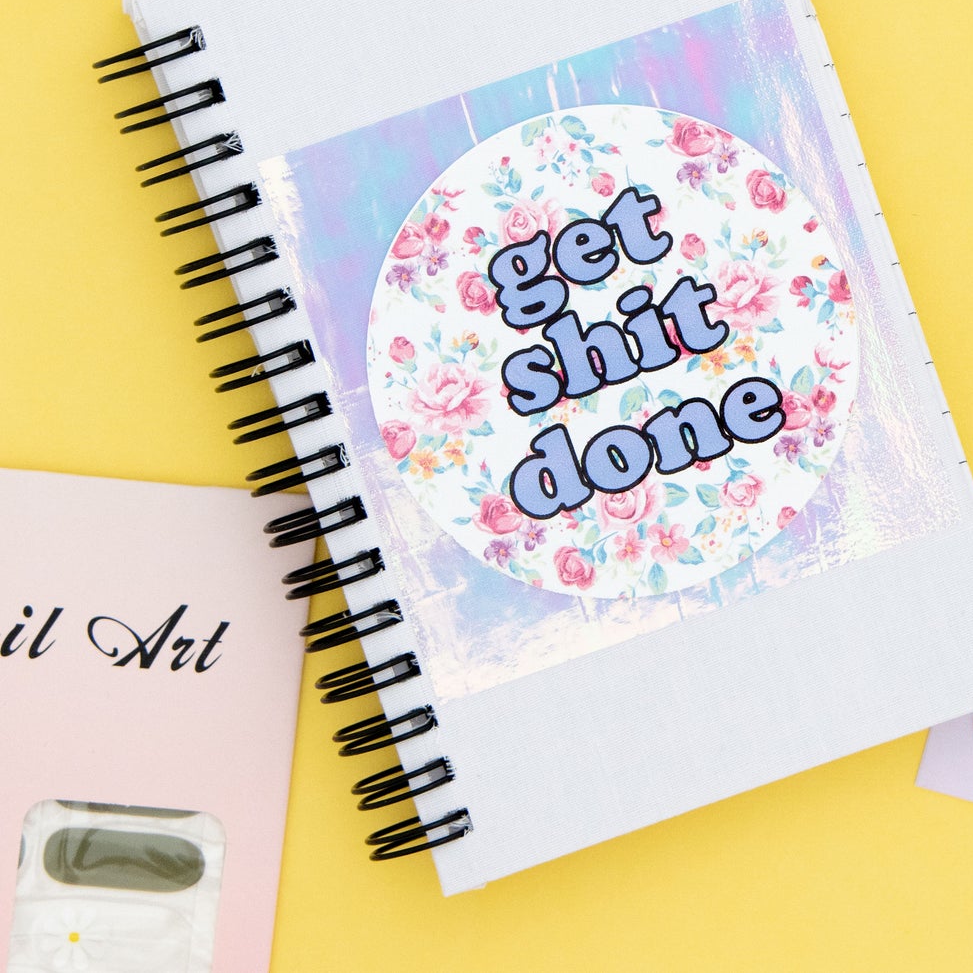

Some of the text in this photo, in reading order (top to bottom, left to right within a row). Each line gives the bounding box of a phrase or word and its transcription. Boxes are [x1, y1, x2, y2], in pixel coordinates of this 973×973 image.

[488, 186, 674, 329] get
[501, 276, 730, 417] shit
[509, 376, 787, 521] done
[87, 604, 230, 674] Art
